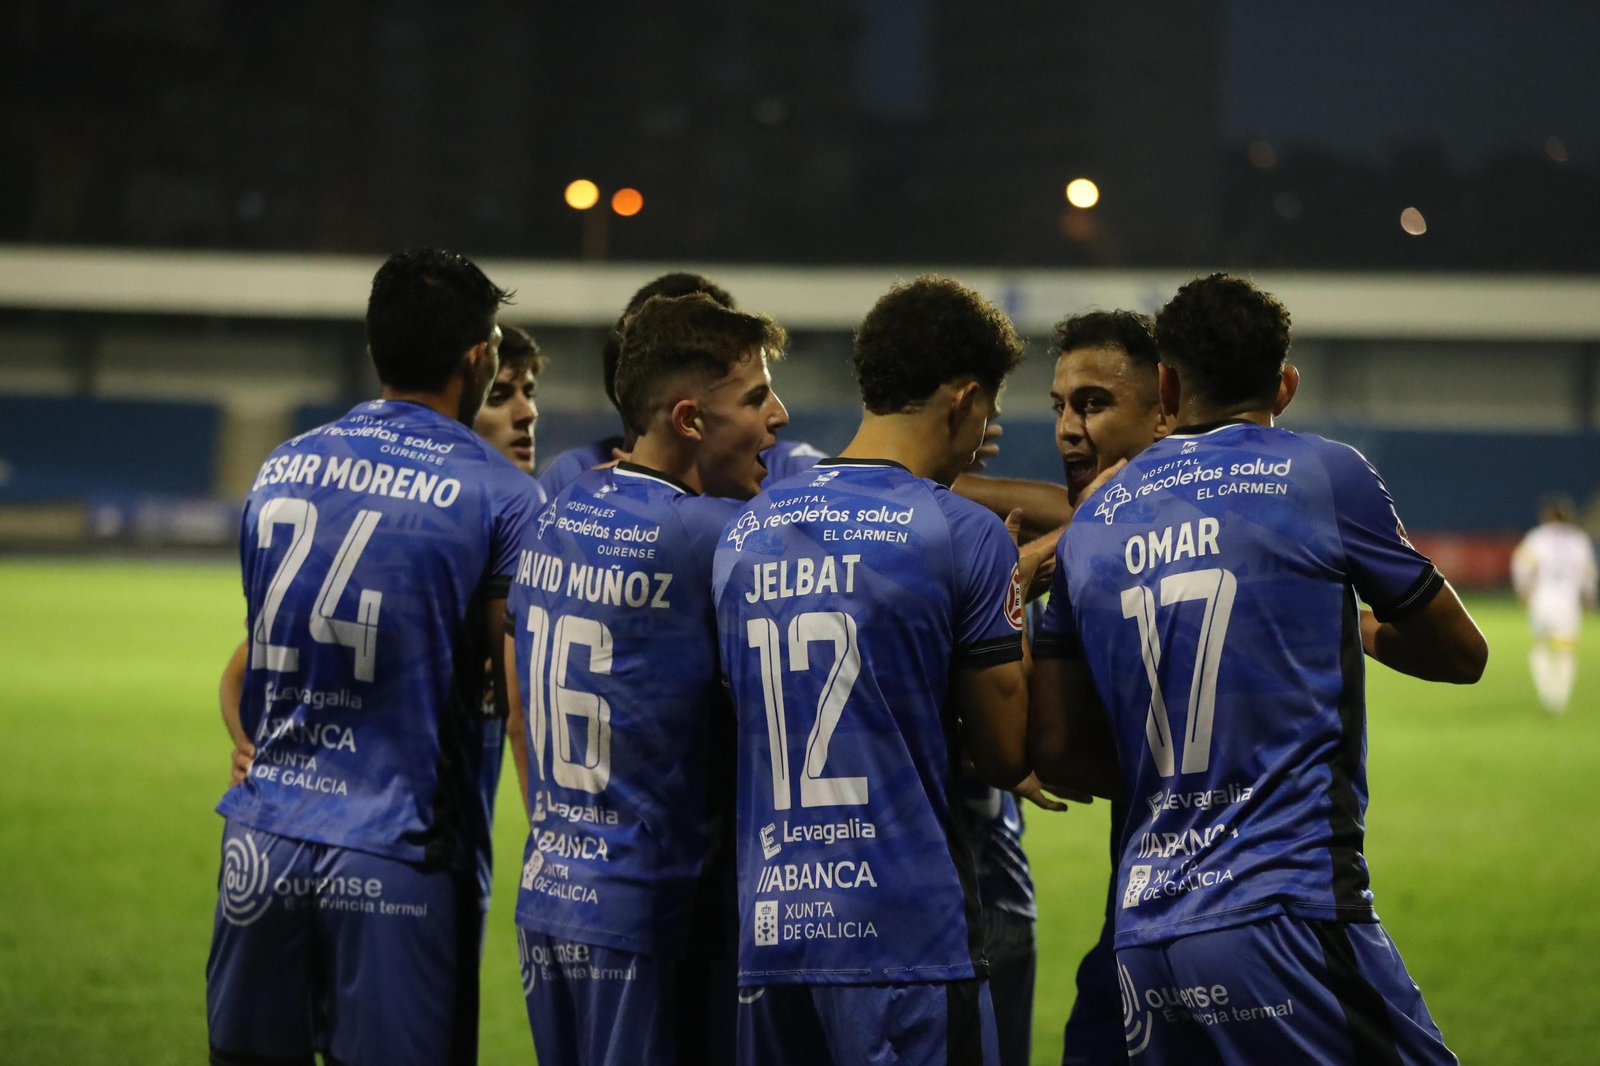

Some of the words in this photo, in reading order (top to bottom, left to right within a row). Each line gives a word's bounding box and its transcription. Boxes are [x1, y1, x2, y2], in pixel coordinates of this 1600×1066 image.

[324, 426, 399, 442] recoletas
[403, 436, 454, 454] salud
[380, 445, 445, 465] OURENSE
[321, 456, 461, 508] MORENO
[1134, 466, 1222, 499] recoletas
[1230, 458, 1292, 477] salud
[1142, 458, 1200, 481] HOSPITAL
[770, 495, 827, 509] HOSPITAL
[1197, 488, 1214, 500] EL
[1217, 483, 1288, 496] CARMEN
[566, 500, 616, 518] HOSPITALES
[763, 506, 850, 529] recoletas
[856, 506, 914, 525] salud
[555, 516, 609, 539] recoletas
[614, 525, 660, 543] salud
[823, 529, 840, 541] EL
[843, 529, 908, 544] CARMEN
[597, 544, 656, 559] OURENSE
[1124, 517, 1220, 575] OMAR
[251, 497, 382, 683] 24
[515, 549, 563, 593] DAVID
[567, 562, 673, 609] MUÑOZ
[745, 554, 861, 604] JELBAT
[1120, 567, 1238, 778] 17
[527, 605, 614, 794] 16
[746, 611, 869, 810] 12
[255, 765, 280, 782] DE
[281, 770, 347, 796] GALICIA
[1162, 783, 1253, 810] Levagalia
[783, 818, 876, 844] Levagalia
[533, 828, 609, 862] BANCA
[274, 875, 382, 898] ounse
[548, 881, 598, 904] GALICIA
[1143, 885, 1161, 901] DE
[1164, 869, 1233, 896] GALICIA
[380, 900, 428, 917] termal
[784, 902, 834, 919] XUNTA
[783, 924, 801, 940] DE
[804, 922, 878, 939] GALICIA
[1144, 984, 1229, 1008] ouense
[1232, 1000, 1293, 1023] termal
